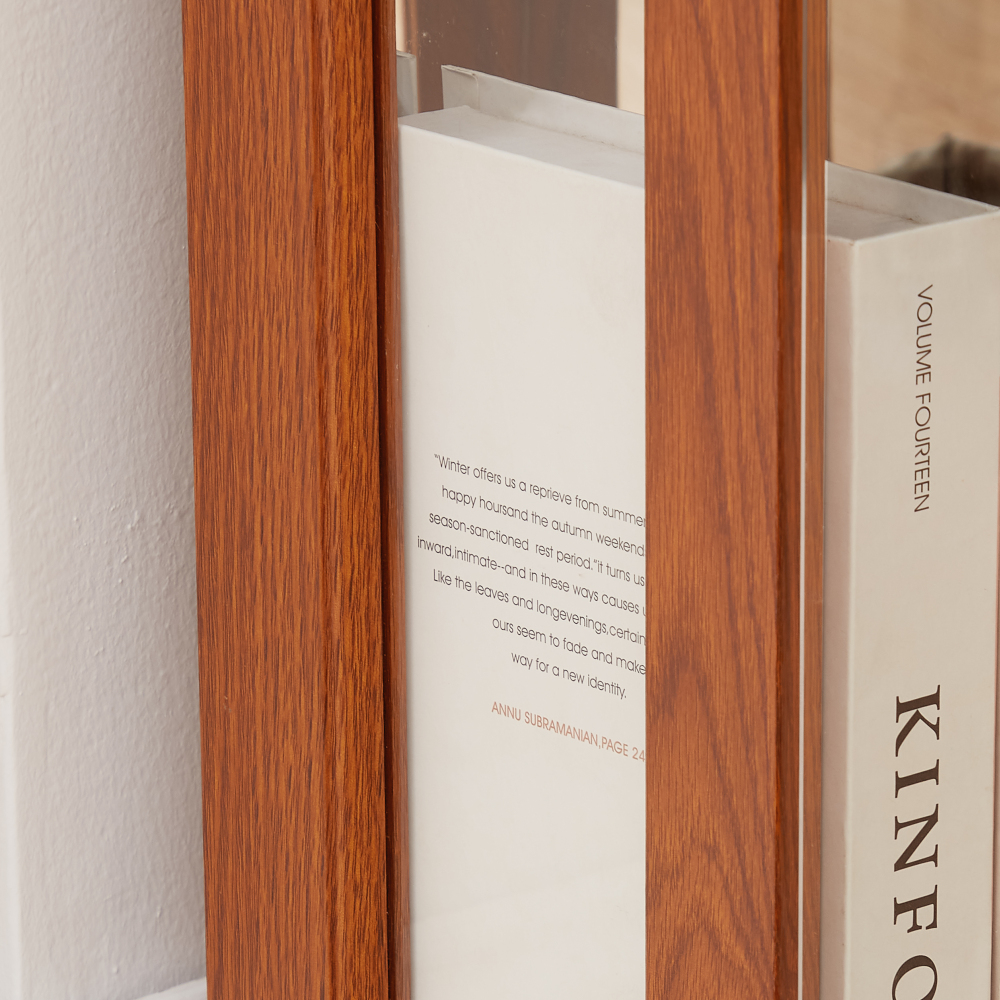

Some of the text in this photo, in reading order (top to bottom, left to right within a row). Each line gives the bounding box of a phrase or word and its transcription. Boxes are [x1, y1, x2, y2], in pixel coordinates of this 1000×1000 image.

[914, 284, 933, 513] VOLUME FOURTEEN
[473, 467, 501, 484] offers
[504, 476, 516, 489] us
[519, 481, 526, 491] a
[530, 483, 572, 505] reprieve
[575, 495, 599, 513] from
[429, 512, 529, 550] season-sanctioned
[536, 543, 553, 558] rest
[606, 562, 630, 582] turns
[634, 574, 645, 586] us
[442, 485, 644, 556] happy hoursand the autumn weekend
[433, 569, 452, 585] Like
[455, 575, 472, 591] the
[475, 581, 508, 603] leaves
[512, 595, 533, 610] and
[529, 568, 537, 582] in
[541, 571, 569, 592] these
[573, 584, 598, 602] ways
[601, 593, 639, 614] causes
[492, 618, 646, 675] ours seem to fade and make
[511, 652, 627, 699] way for a new identity.
[492, 701, 521, 721] ANNU
[632, 747, 645, 762] 24
